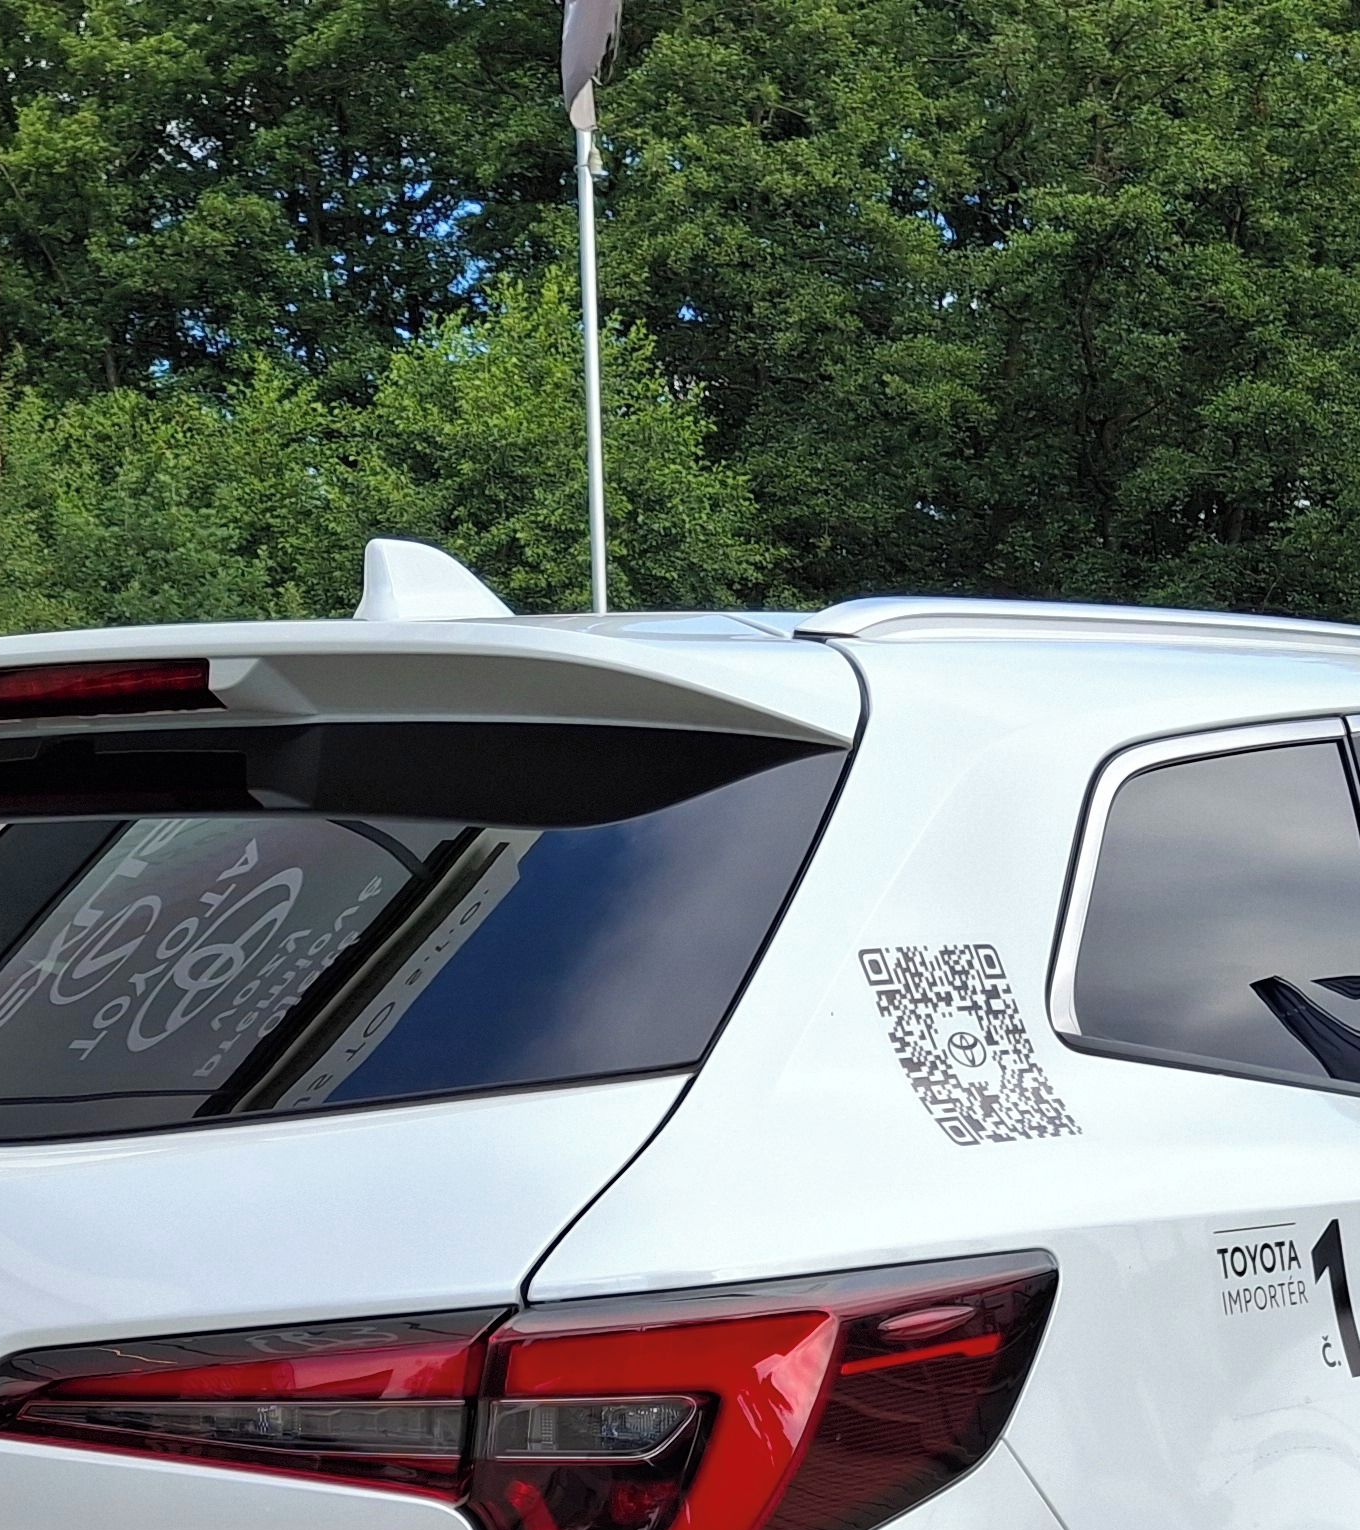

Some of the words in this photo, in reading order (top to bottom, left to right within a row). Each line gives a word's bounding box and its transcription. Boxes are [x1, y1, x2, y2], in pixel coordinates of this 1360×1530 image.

[1217, 1240, 1302, 1280] TOYOTA
[1222, 1275, 1309, 1316] IMPORTÉR
[1321, 1335, 1342, 1368] Č.
